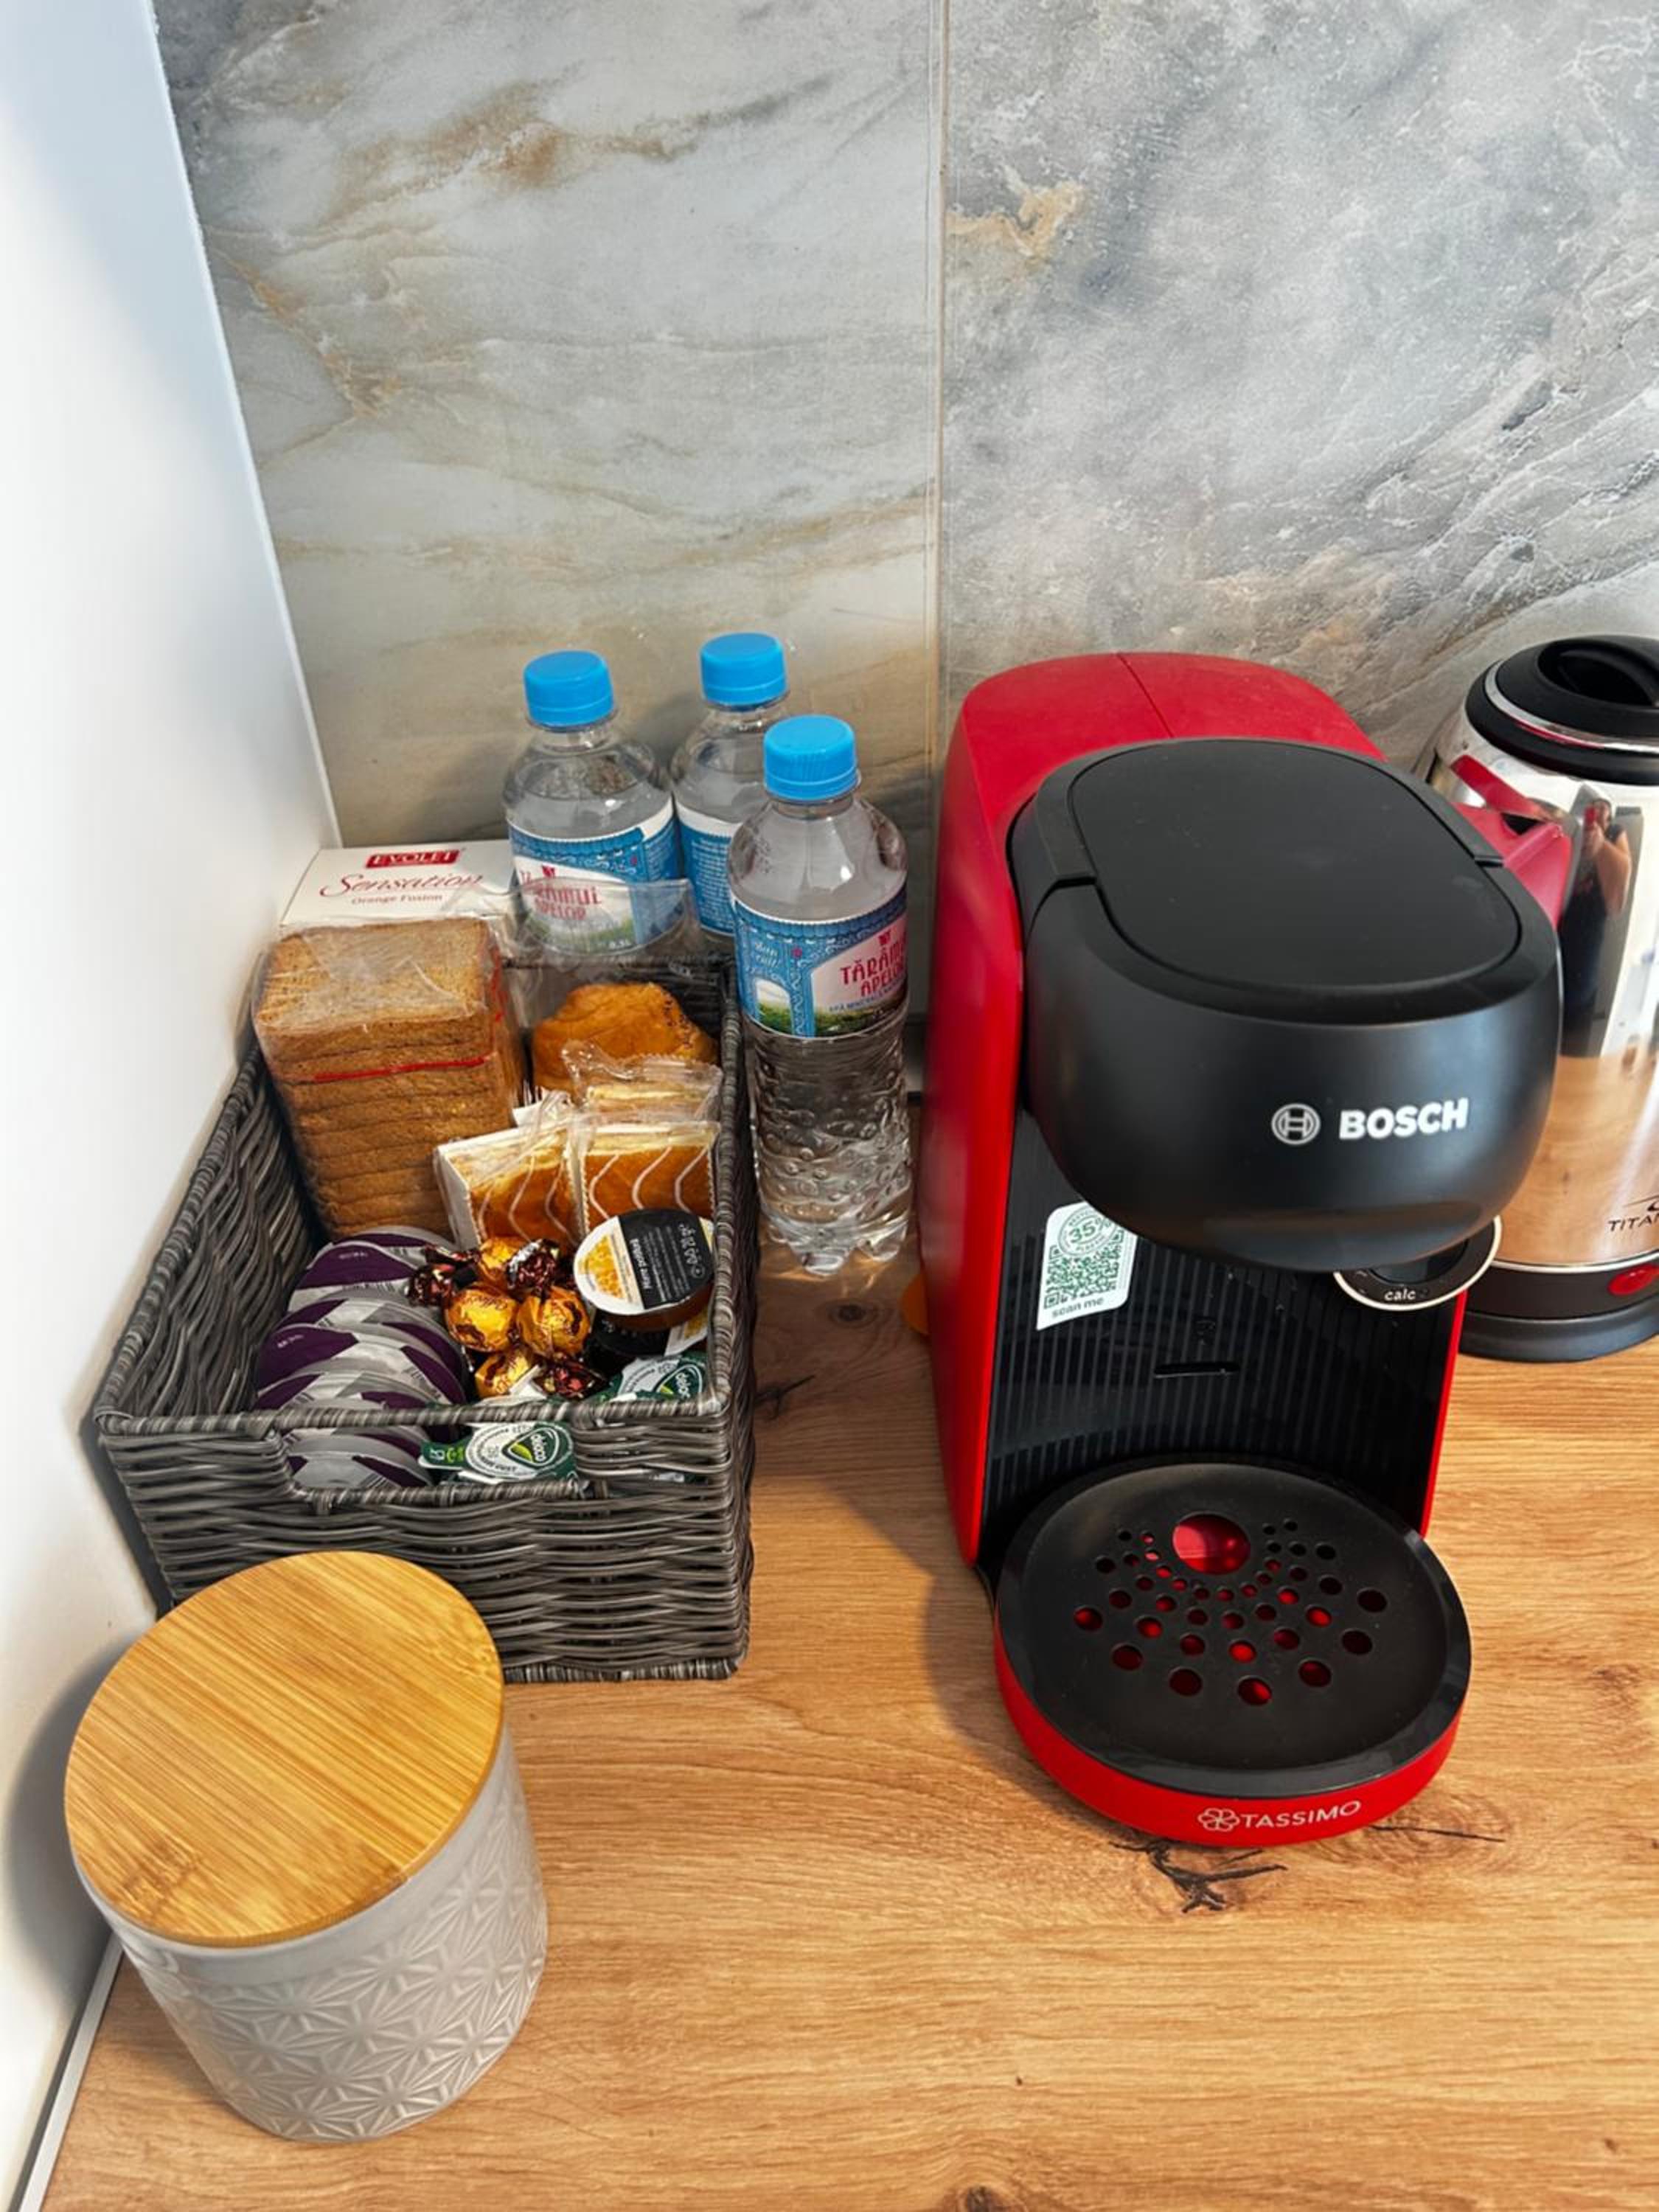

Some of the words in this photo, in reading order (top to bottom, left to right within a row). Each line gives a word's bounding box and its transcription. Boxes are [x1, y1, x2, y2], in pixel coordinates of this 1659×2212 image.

[319, 873, 484, 897] Sensation
[351, 895, 397, 905] Orange
[400, 894, 443, 902] Fusion
[1339, 1098, 1468, 1139] BOSCH
[1384, 1289, 1416, 1301] calc
[1052, 1303, 1081, 1318] scan
[1083, 1298, 1104, 1308] me
[1241, 1800, 1362, 1829] TASSIMO
